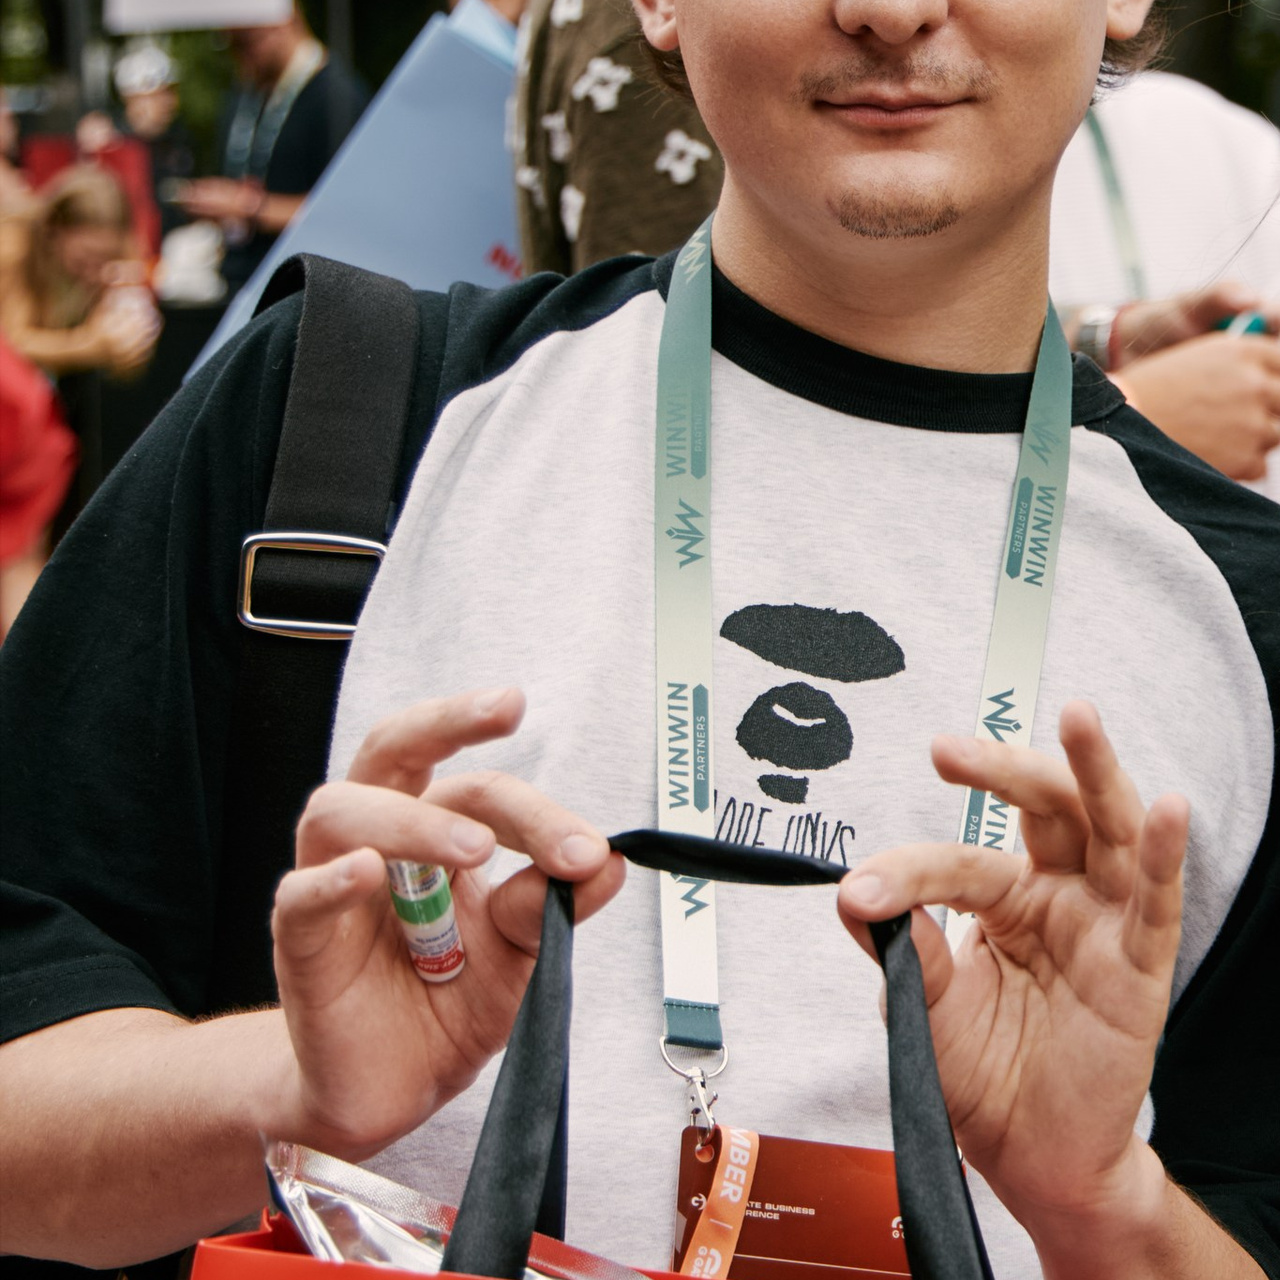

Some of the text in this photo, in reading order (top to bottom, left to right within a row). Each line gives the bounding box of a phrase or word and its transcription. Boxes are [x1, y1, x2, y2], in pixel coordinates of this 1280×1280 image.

[666, 390, 688, 478] WINWI
[1012, 501, 1028, 554] PARTNERS
[1023, 486, 1057, 588] WINWIN
[667, 682, 690, 810] WINWIN
[696, 715, 706, 781] PARTNERS
[966, 814, 979, 846] PART
[983, 793, 1010, 851] WIN
[720, 1128, 751, 1204] MBER
[745, 1210, 780, 1220] RENCE
[765, 1203, 816, 1216] BUSINESS
